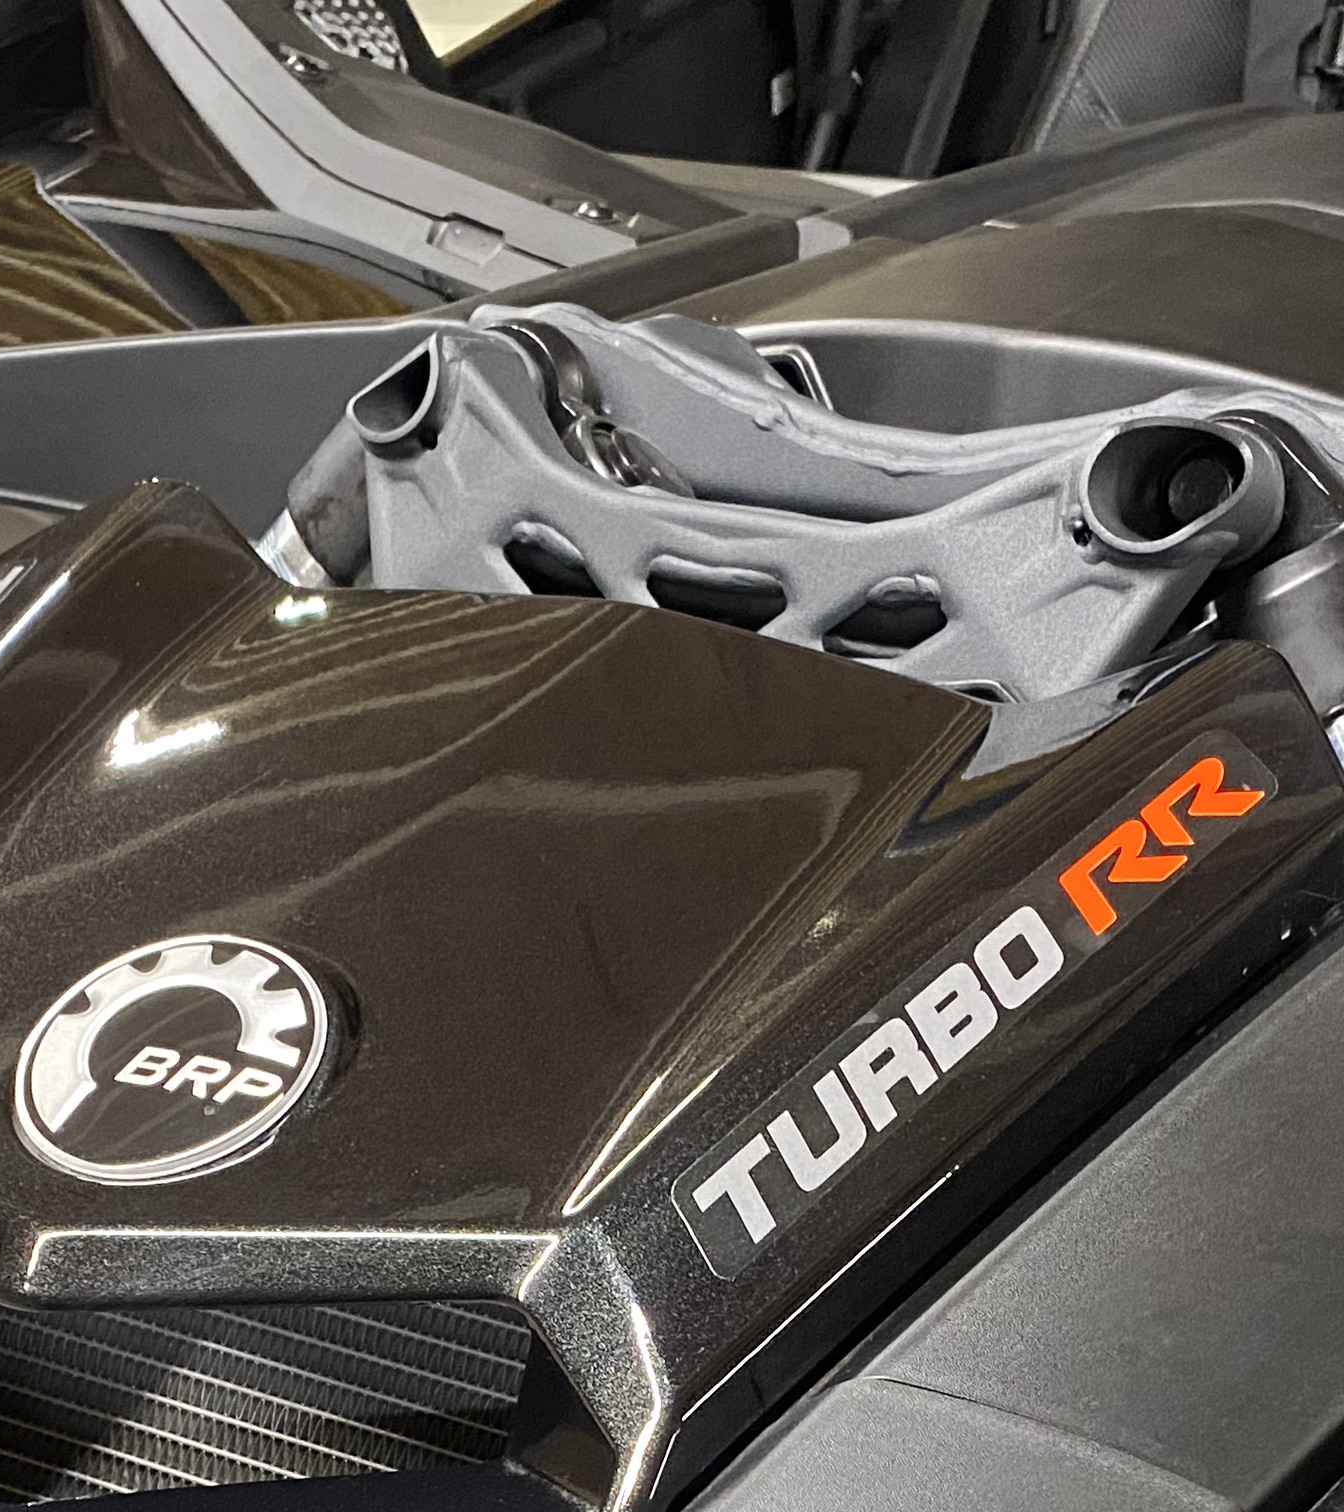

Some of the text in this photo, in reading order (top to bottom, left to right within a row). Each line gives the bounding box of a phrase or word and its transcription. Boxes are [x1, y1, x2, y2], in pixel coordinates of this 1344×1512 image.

[113, 1046, 284, 1105] BRP
[692, 757, 1263, 1245] TURBO RR
